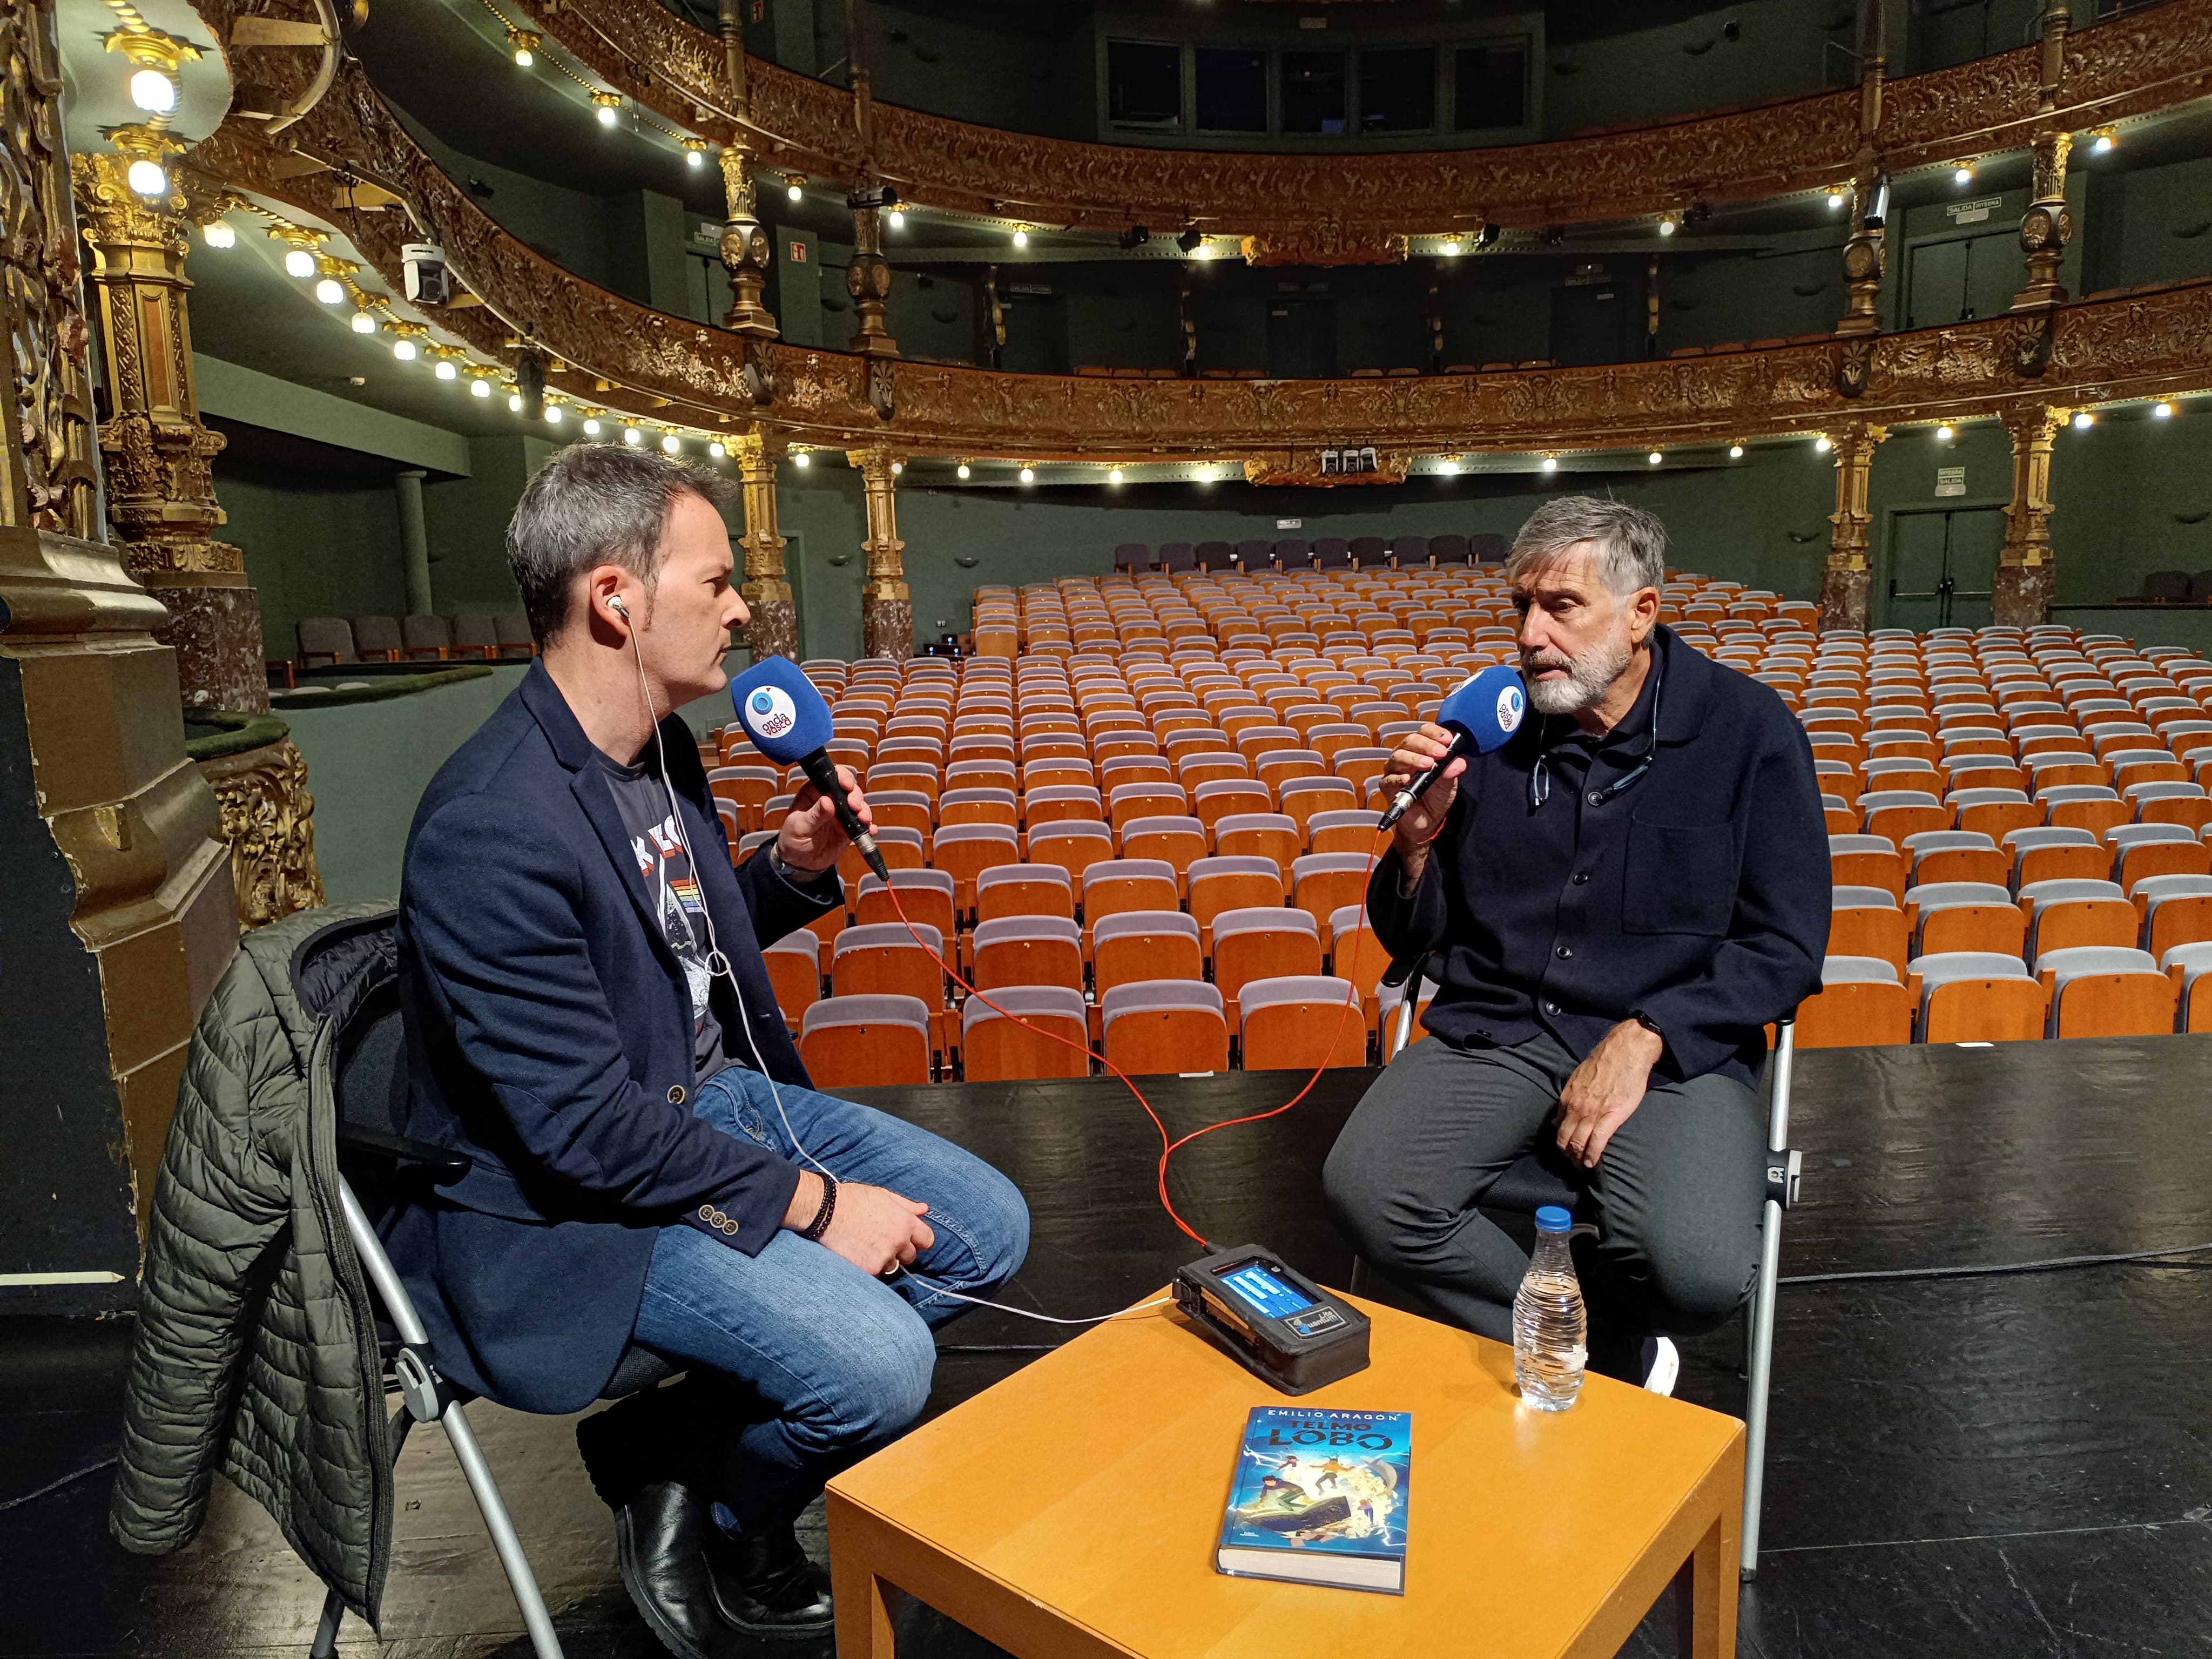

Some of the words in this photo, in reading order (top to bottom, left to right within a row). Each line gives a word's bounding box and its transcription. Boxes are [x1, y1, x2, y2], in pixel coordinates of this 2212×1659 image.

[1949, 205, 1972, 214] SALIDA
[1975, 200, 1999, 208] IRTEERA
[762, 713, 788, 731] onda
[766, 718, 792, 736] vasca
[1289, 1420, 1372, 1431] TELMO
[1269, 1428, 1393, 1451] LOBO
